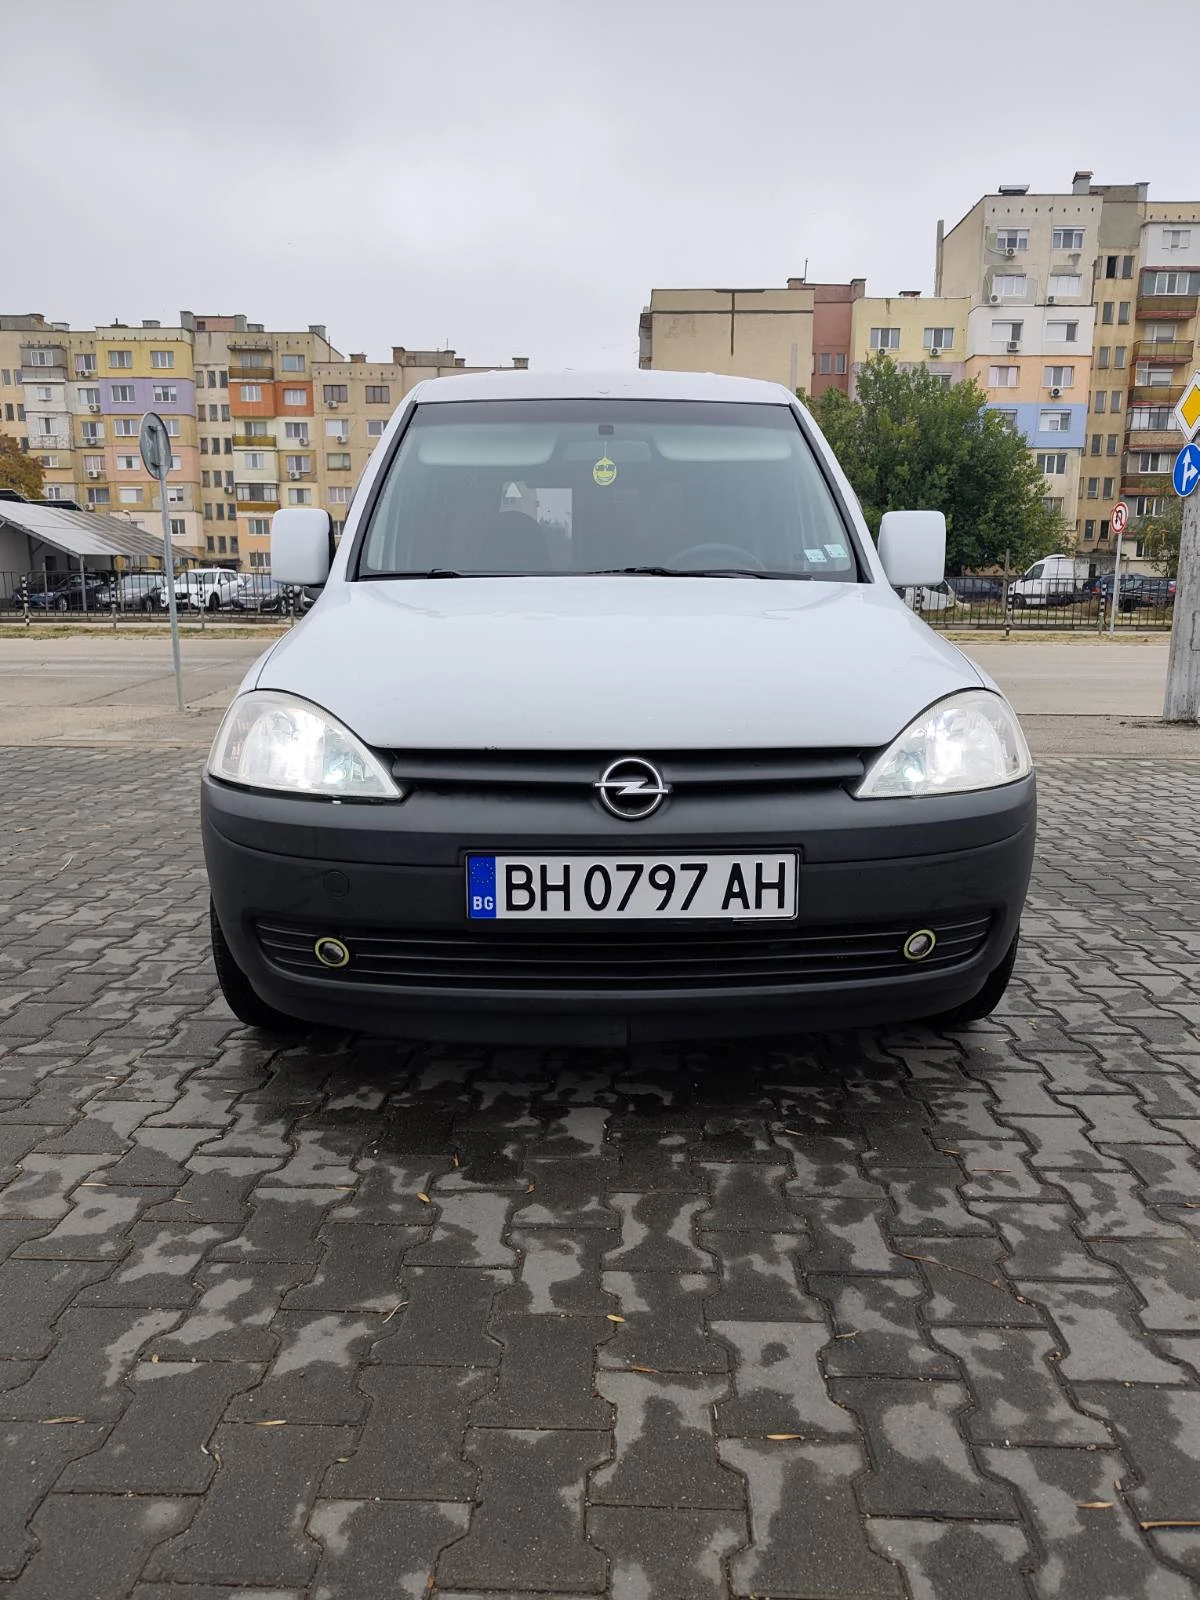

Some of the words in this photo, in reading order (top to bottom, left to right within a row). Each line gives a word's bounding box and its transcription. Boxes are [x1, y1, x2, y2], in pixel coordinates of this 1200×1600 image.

[505, 864, 571, 912] BH
[583, 863, 708, 912] 0797
[721, 862, 786, 910] AH
[473, 896, 494, 911] BG
